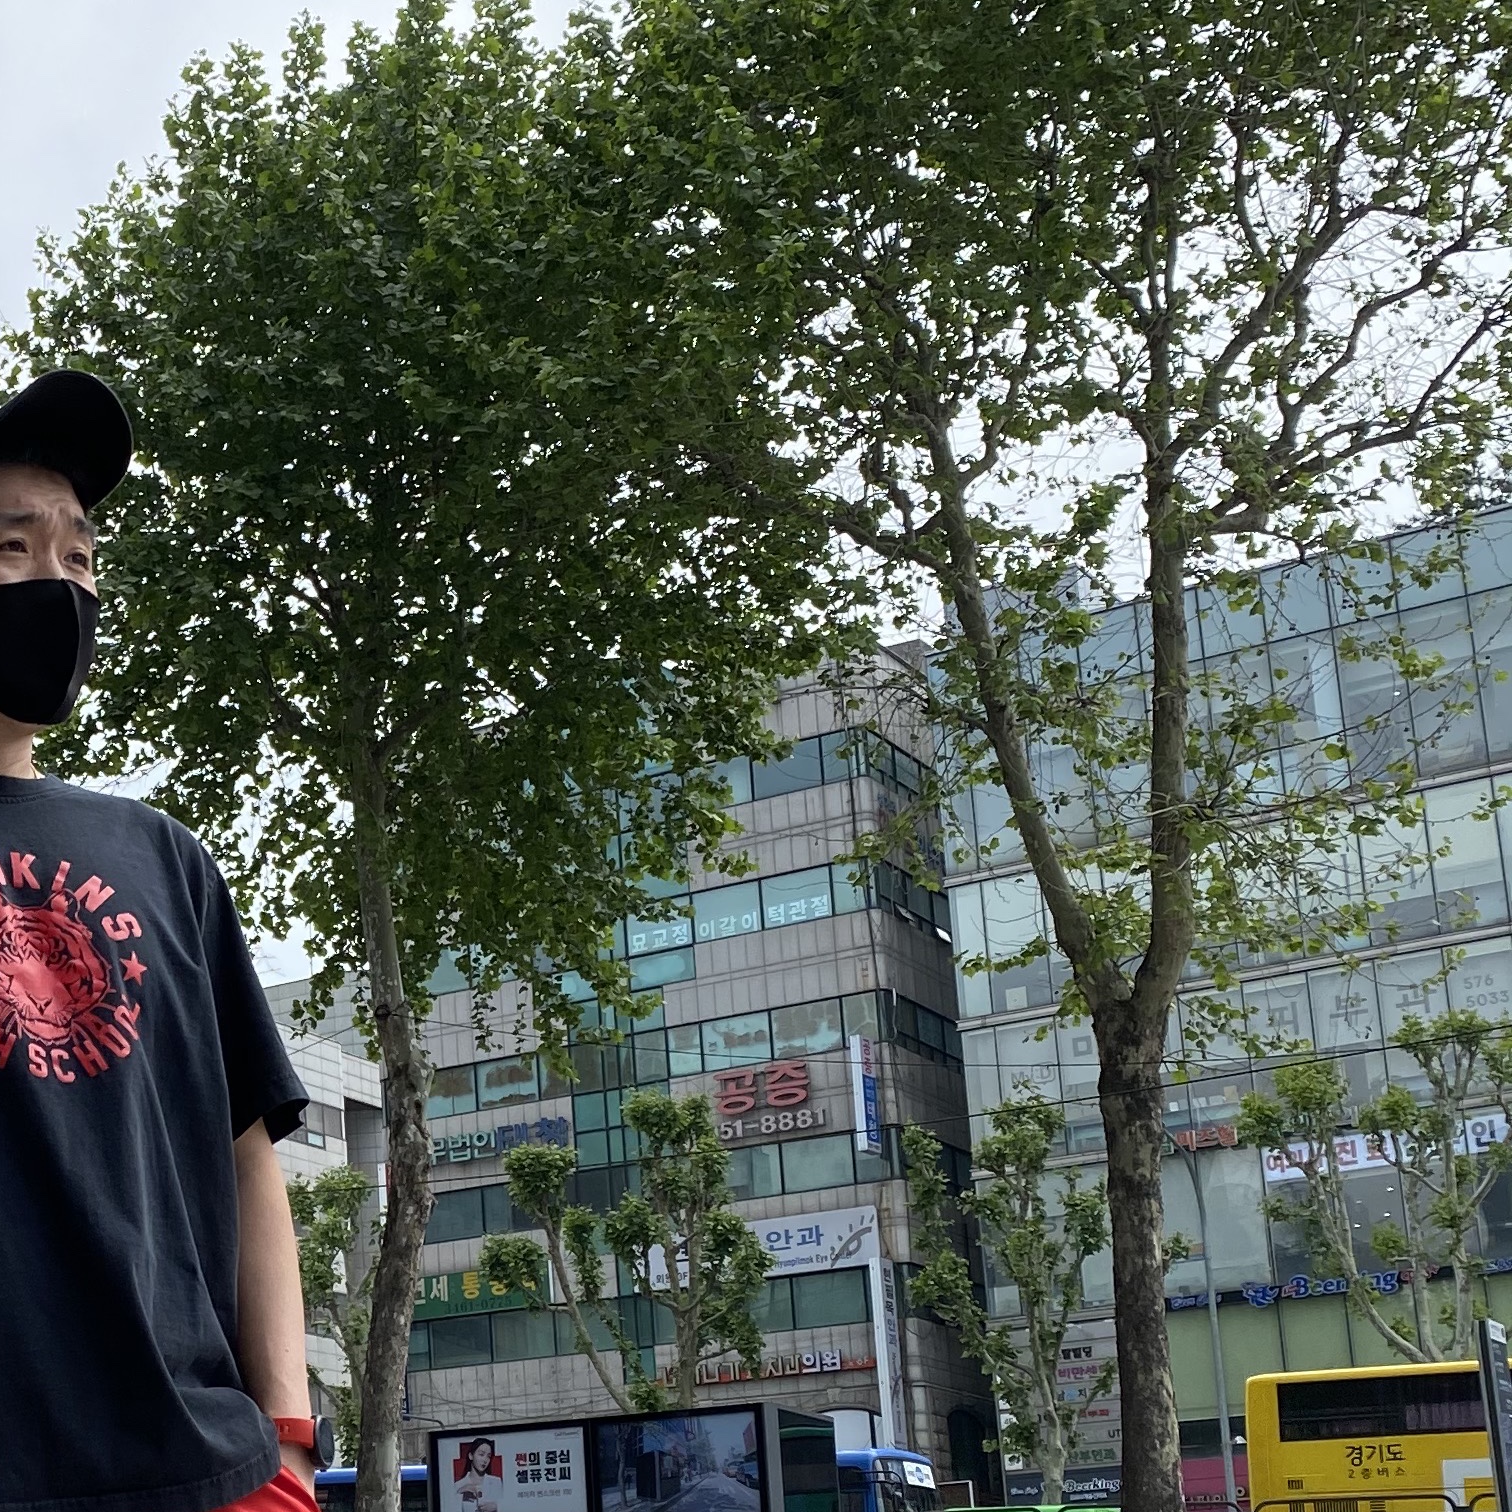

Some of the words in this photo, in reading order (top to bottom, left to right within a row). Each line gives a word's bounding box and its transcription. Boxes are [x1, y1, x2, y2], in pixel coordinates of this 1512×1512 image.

[699, 911, 758, 940] 이갈이
[767, 894, 830, 924] 턱관절
[713, 1060, 810, 1116] 공증
[766, 1224, 825, 1252] 안과
[545, 1449, 571, 1465] 중심
[1345, 1443, 1406, 1467] 경기도
